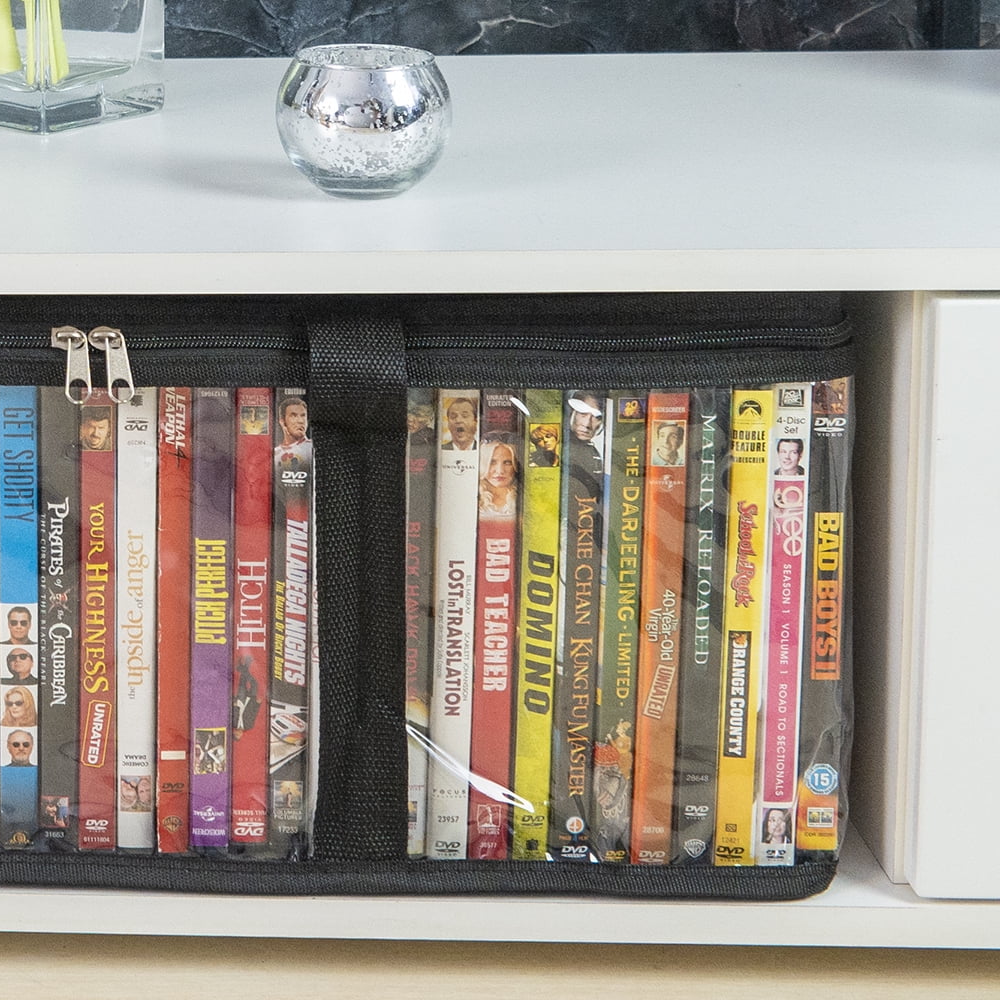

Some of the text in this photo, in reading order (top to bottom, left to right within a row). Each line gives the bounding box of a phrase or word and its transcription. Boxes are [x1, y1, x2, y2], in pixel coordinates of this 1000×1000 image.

[173, 394, 186, 449] LETHAL
[733, 429, 765, 440] DOUBLE
[776, 416, 806, 425] 4-Disc
[784, 426, 799, 434] Set
[814, 417, 847, 427] DVD
[3, 406, 37, 524] GET SHORTY
[732, 441, 766, 452] FEATURE
[281, 471, 308, 480] DVD
[694, 414, 717, 665] MATRIX RELOADED
[773, 485, 805, 557] glee
[616, 445, 640, 699] THE DARJEELING LIMITED
[731, 500, 759, 609] School Rock
[40, 574, 47, 590] OF
[47, 496, 73, 707] PIRATES of CARIBBEAN
[83, 501, 110, 694] YOUR HIGHNESS
[194, 537, 230, 645] PITCH PERFECT
[283, 518, 308, 687] TALLADEGA NIGHTS
[781, 563, 792, 605] SEASON
[815, 511, 840, 680] BAD BOYS II
[121, 528, 151, 700] the upside of anger
[236, 558, 268, 650] HITCH
[275, 594, 285, 620] BALLAD
[482, 538, 511, 692] BAD TEACHER
[645, 607, 662, 642] Virgin
[660, 588, 676, 661] 40-Year-Old
[275, 620, 285, 633] OF
[275, 633, 285, 655] RICKY
[444, 560, 465, 717] LOST in TRANSLATION
[523, 550, 556, 716] DOMINO
[567, 495, 597, 797] JACKIE CHAN KUNG FU MASTER
[779, 623, 790, 666] VOLUME
[274, 656, 284, 681] BOBBY
[462, 662, 470, 702] JOHANSSON
[644, 666, 673, 717] UNRATED
[728, 632, 748, 757] ORANGE COUNTY
[777, 683, 788, 714] ROAD
[87, 702, 106, 764] UNRATED
[777, 716, 787, 731] TO
[775, 734, 787, 797] SECTIONALS
[813, 773, 830, 787] 15
[85, 819, 108, 827] DVD
[685, 804, 709, 812] DVD
[192, 828, 226, 836] WIDESCREEN
[234, 827, 265, 836] DVD
[435, 841, 461, 849] DVD
[561, 845, 588, 854] DVD
[716, 845, 745, 855] DVD
